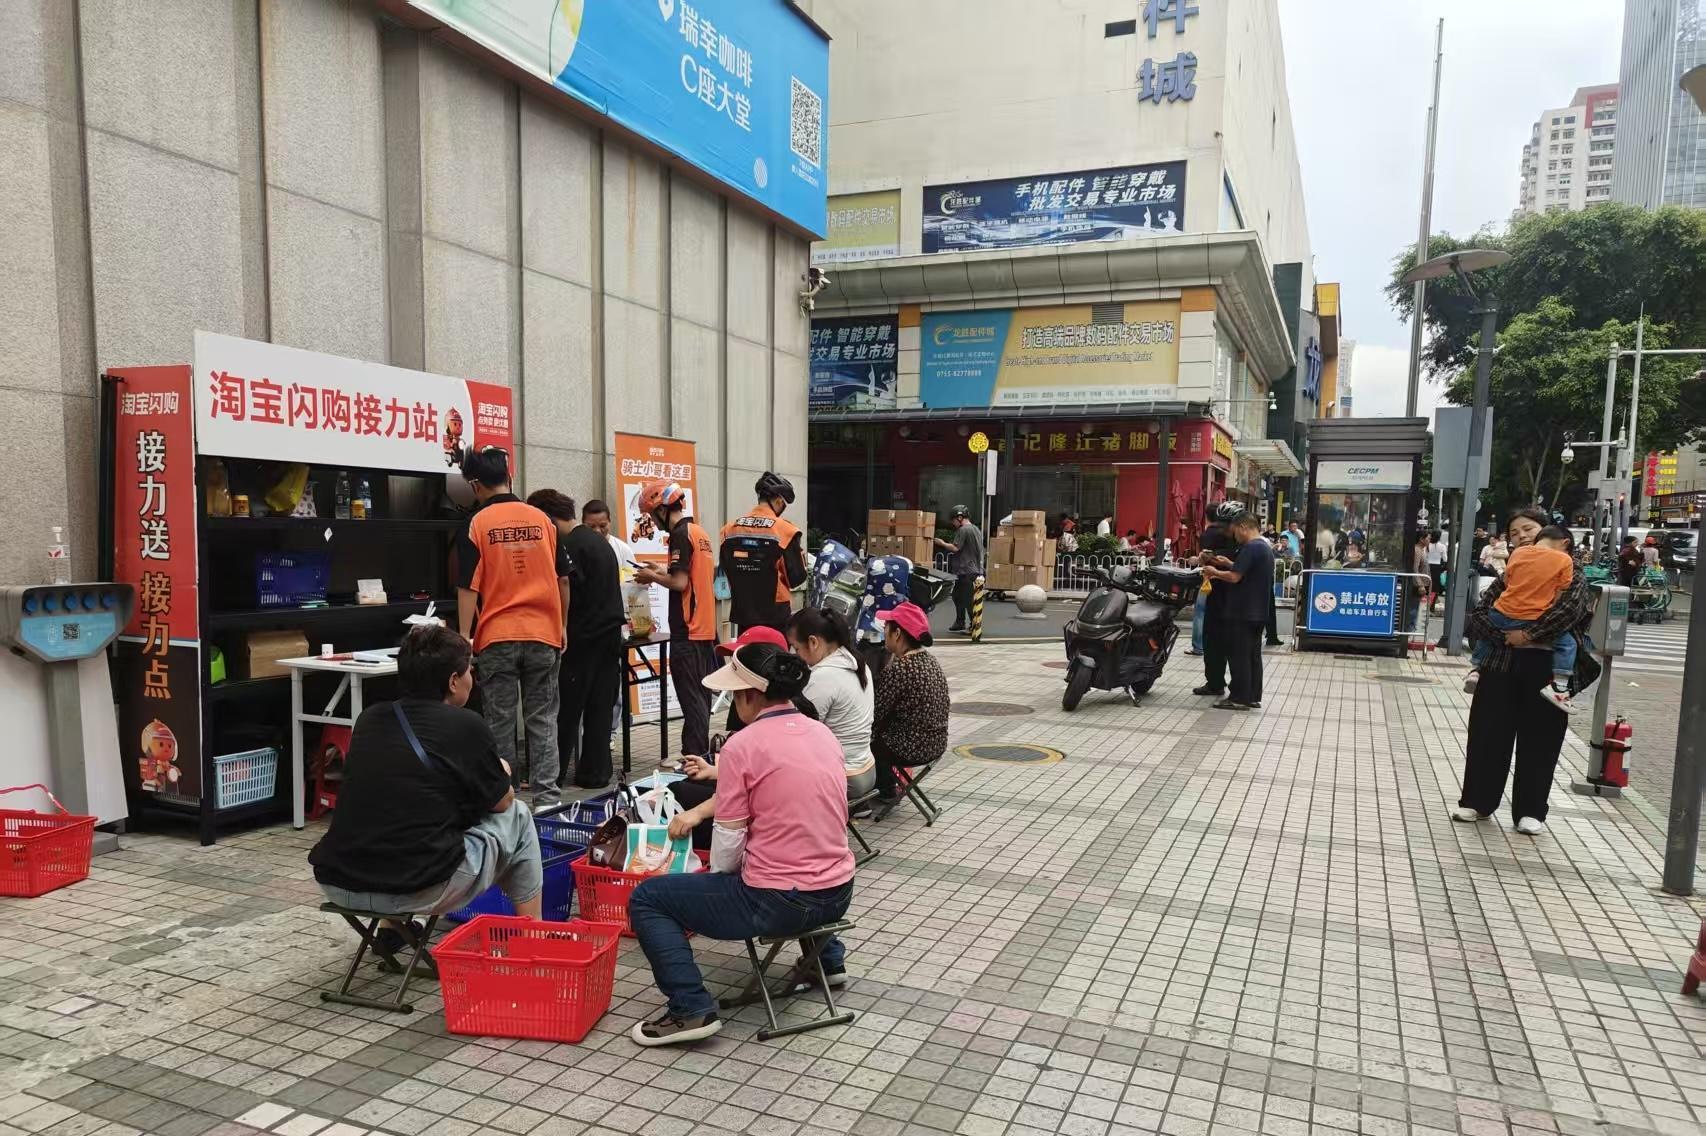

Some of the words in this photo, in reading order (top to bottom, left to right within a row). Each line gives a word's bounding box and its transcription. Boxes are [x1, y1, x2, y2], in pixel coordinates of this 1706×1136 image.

[679, 1, 752, 88] 瑞幸咖啡
[681, 54, 752, 132] C座大堂
[1015, 177, 1086, 198] 手机配件
[1092, 169, 1167, 192] 智能穿戴
[1028, 184, 1176, 211] 批发交易专业市场
[837, 325, 891, 343] 智能穿戴
[1022, 321, 1175, 349] 打造高端品牌数码配件交易市场
[120, 391, 179, 416] 淘宝闪购
[209, 370, 439, 443] 淘宝闪购接力站
[478, 401, 508, 418] 淘宝闪购
[621, 459, 692, 480] 骑士小哥看这里
[1347, 467, 1379, 475] CECPM
[137, 430, 171, 561] 接力送
[488, 526, 543, 545] 淘宝闪购
[1339, 607, 1388, 617] 电动车及自行车
[1340, 591, 1389, 607] 禁止停放
[140, 571, 172, 700] 接力点
